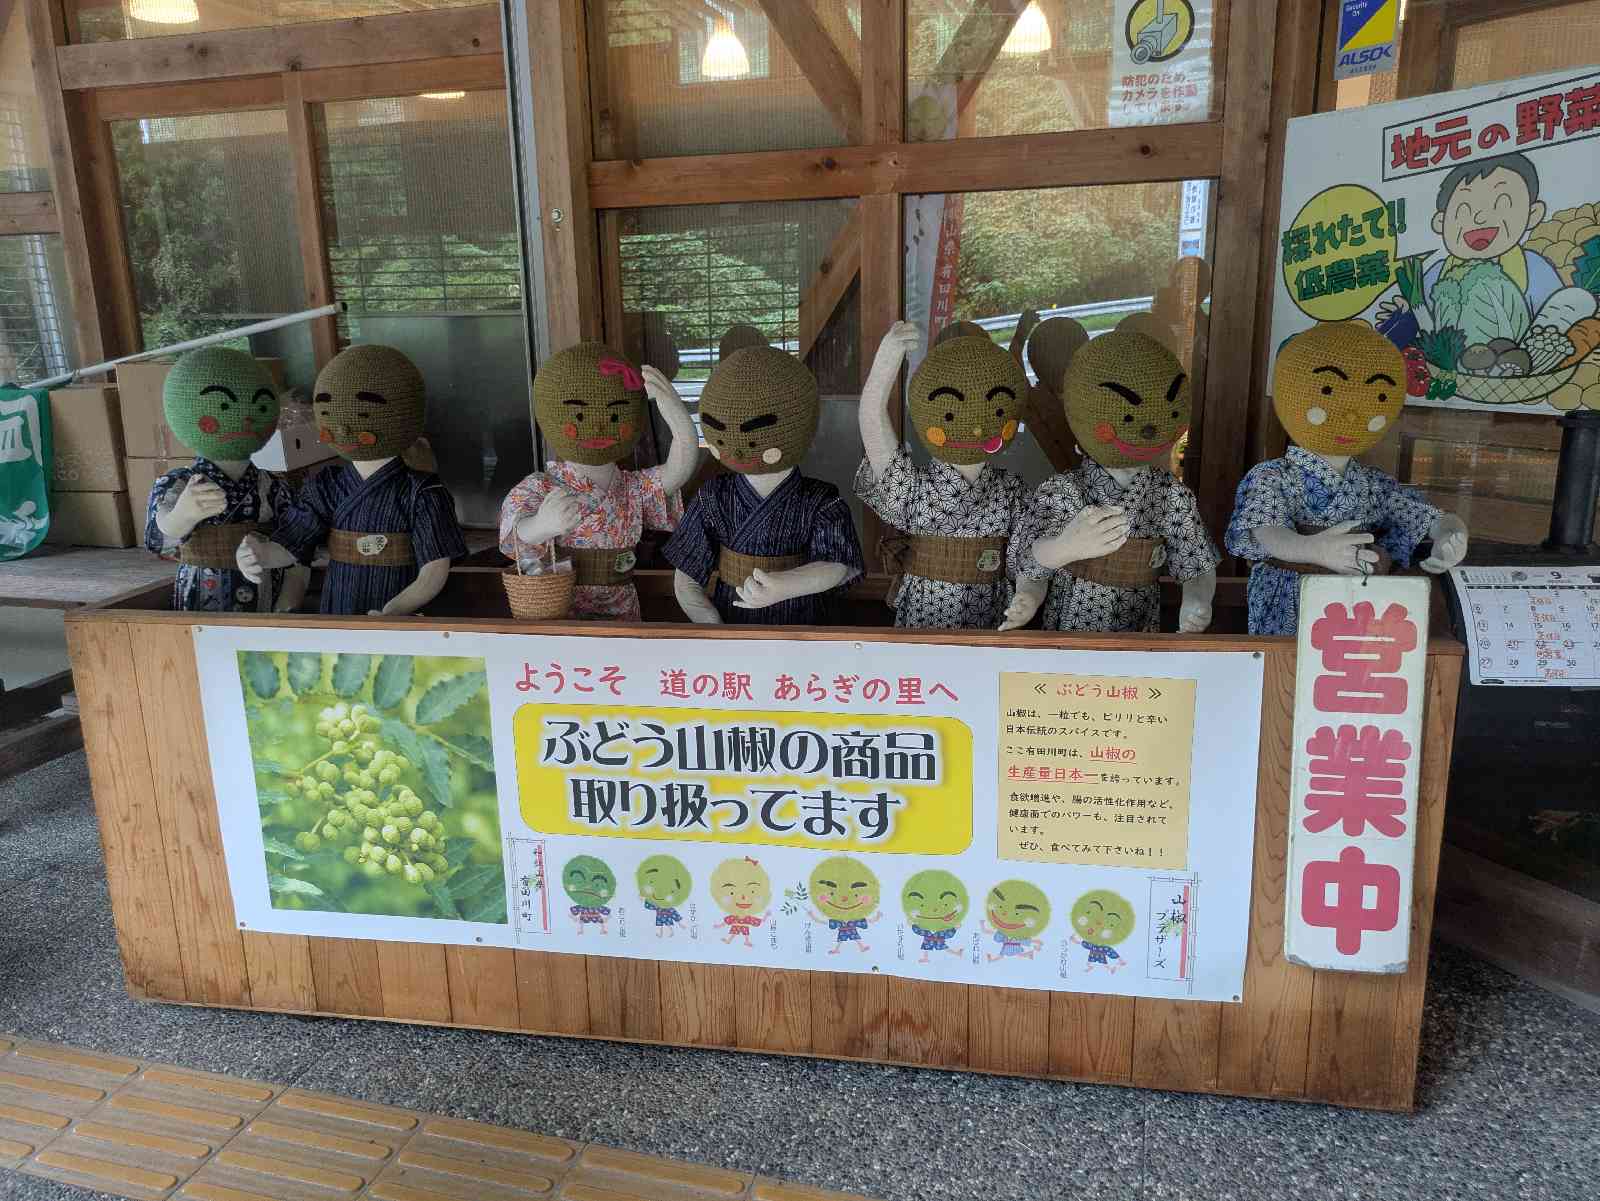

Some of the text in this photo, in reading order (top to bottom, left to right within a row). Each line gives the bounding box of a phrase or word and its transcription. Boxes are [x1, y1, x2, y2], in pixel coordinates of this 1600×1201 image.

[1338, 44, 1393, 67] ALSOK
[1391, 82, 1600, 169] 地元の野菜
[1295, 249, 1391, 301] 低農薬
[515, 662, 959, 705] ようこそ 道の駅 あらぎの里へ
[1056, 683, 1139, 701] ぶどう山椒
[543, 720, 937, 782] ぶどう山椒の商品
[1006, 724, 1128, 740] 日本伝統のスパイスです。
[1301, 600, 1418, 956] 営業中
[570, 777, 903, 840] 取り扱ってます
[1009, 825, 1045, 836] います。
[520, 875, 533, 922] 有田川町
[1170, 894, 1188, 924] 山椒
[1153, 911, 1168, 969] ブラザーズ
